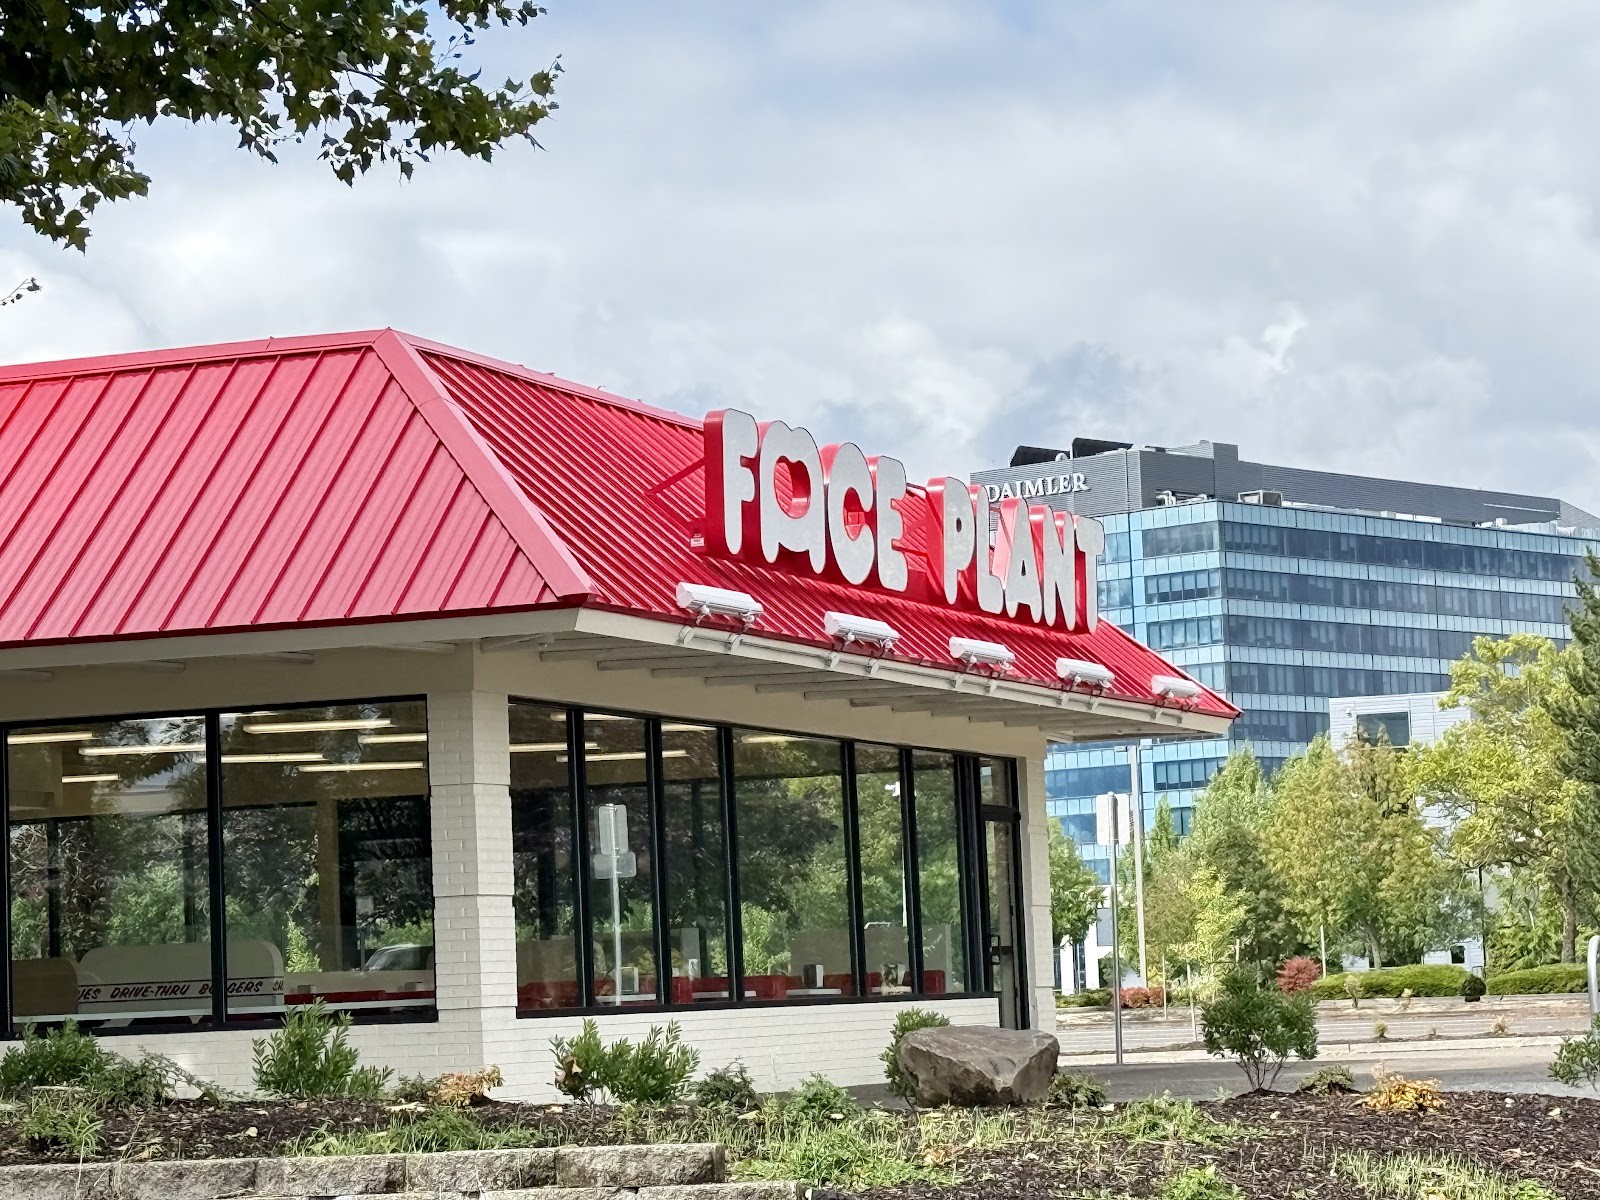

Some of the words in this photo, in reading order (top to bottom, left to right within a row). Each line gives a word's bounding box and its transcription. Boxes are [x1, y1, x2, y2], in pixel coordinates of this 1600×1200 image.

[985, 472, 1091, 503] DAIMLER
[719, 408, 908, 593] FACE
[942, 476, 1105, 635] PLANT
[77, 987, 101, 1001] IES
[110, 984, 191, 999] DRIVE-THRU
[198, 980, 264, 995] BGERS
